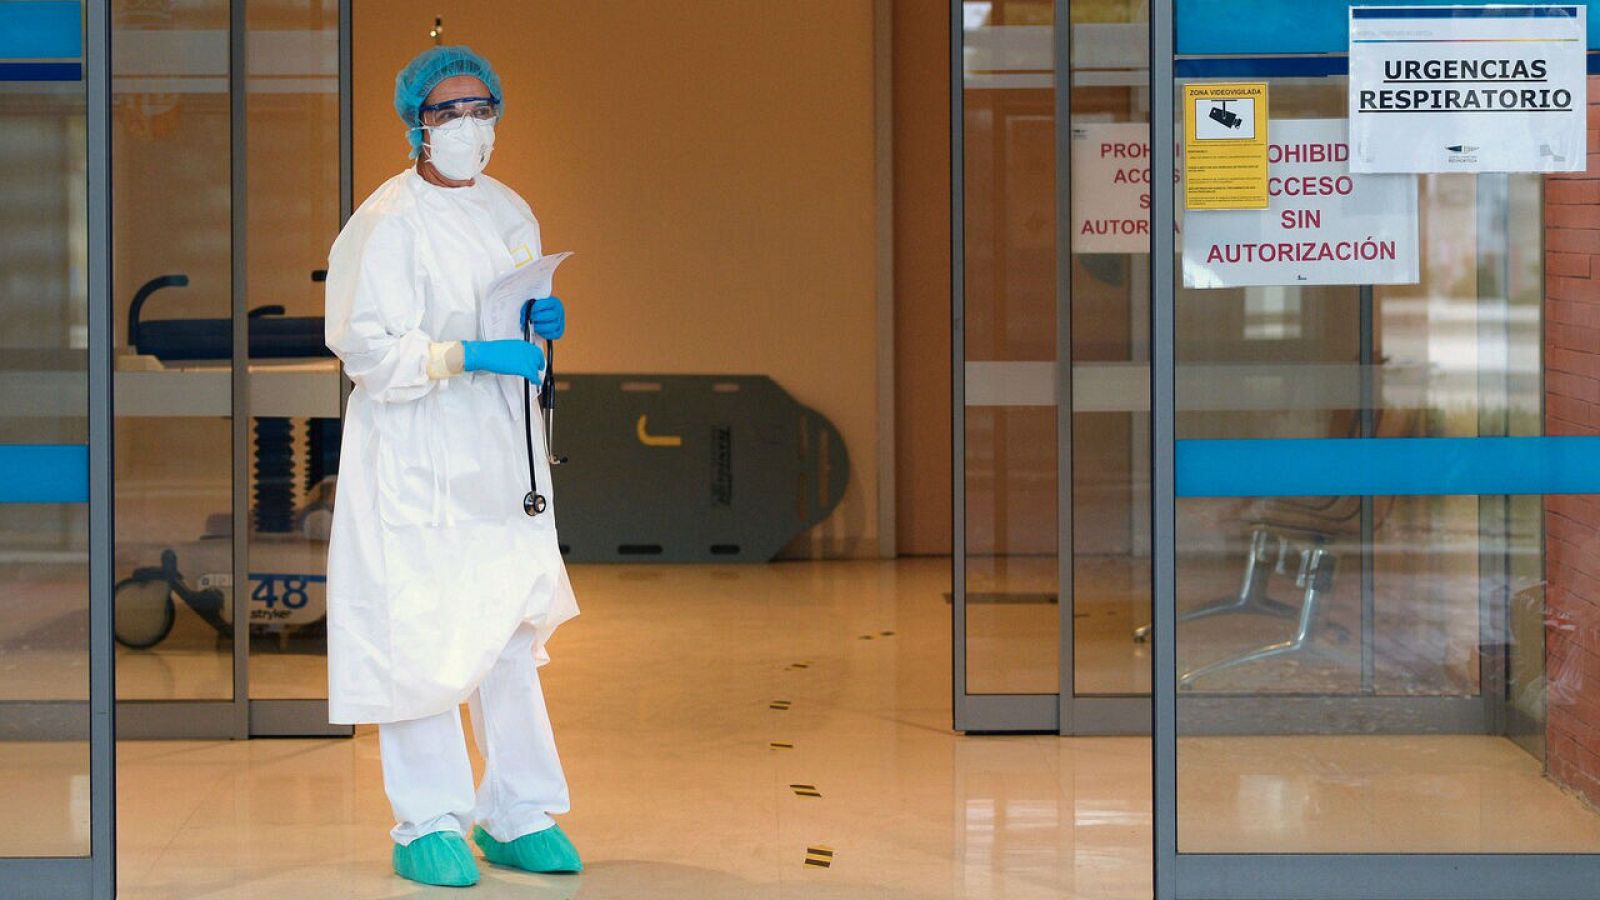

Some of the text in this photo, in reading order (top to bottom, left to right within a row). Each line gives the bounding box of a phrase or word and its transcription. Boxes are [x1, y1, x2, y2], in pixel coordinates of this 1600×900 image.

[1384, 59, 1547, 80] URGENCIAS
[1210, 88, 1262, 96] VIDEOVIGILADA
[1359, 88, 1572, 109] RESPIRATORIO
[1268, 143, 1349, 164] OHIBID
[1269, 175, 1353, 196] CCESO
[1281, 209, 1321, 229] SIN
[1207, 236, 1396, 263] AUTORIZACIÓN
[252, 577, 308, 609] 48
[250, 609, 292, 620] stryker
